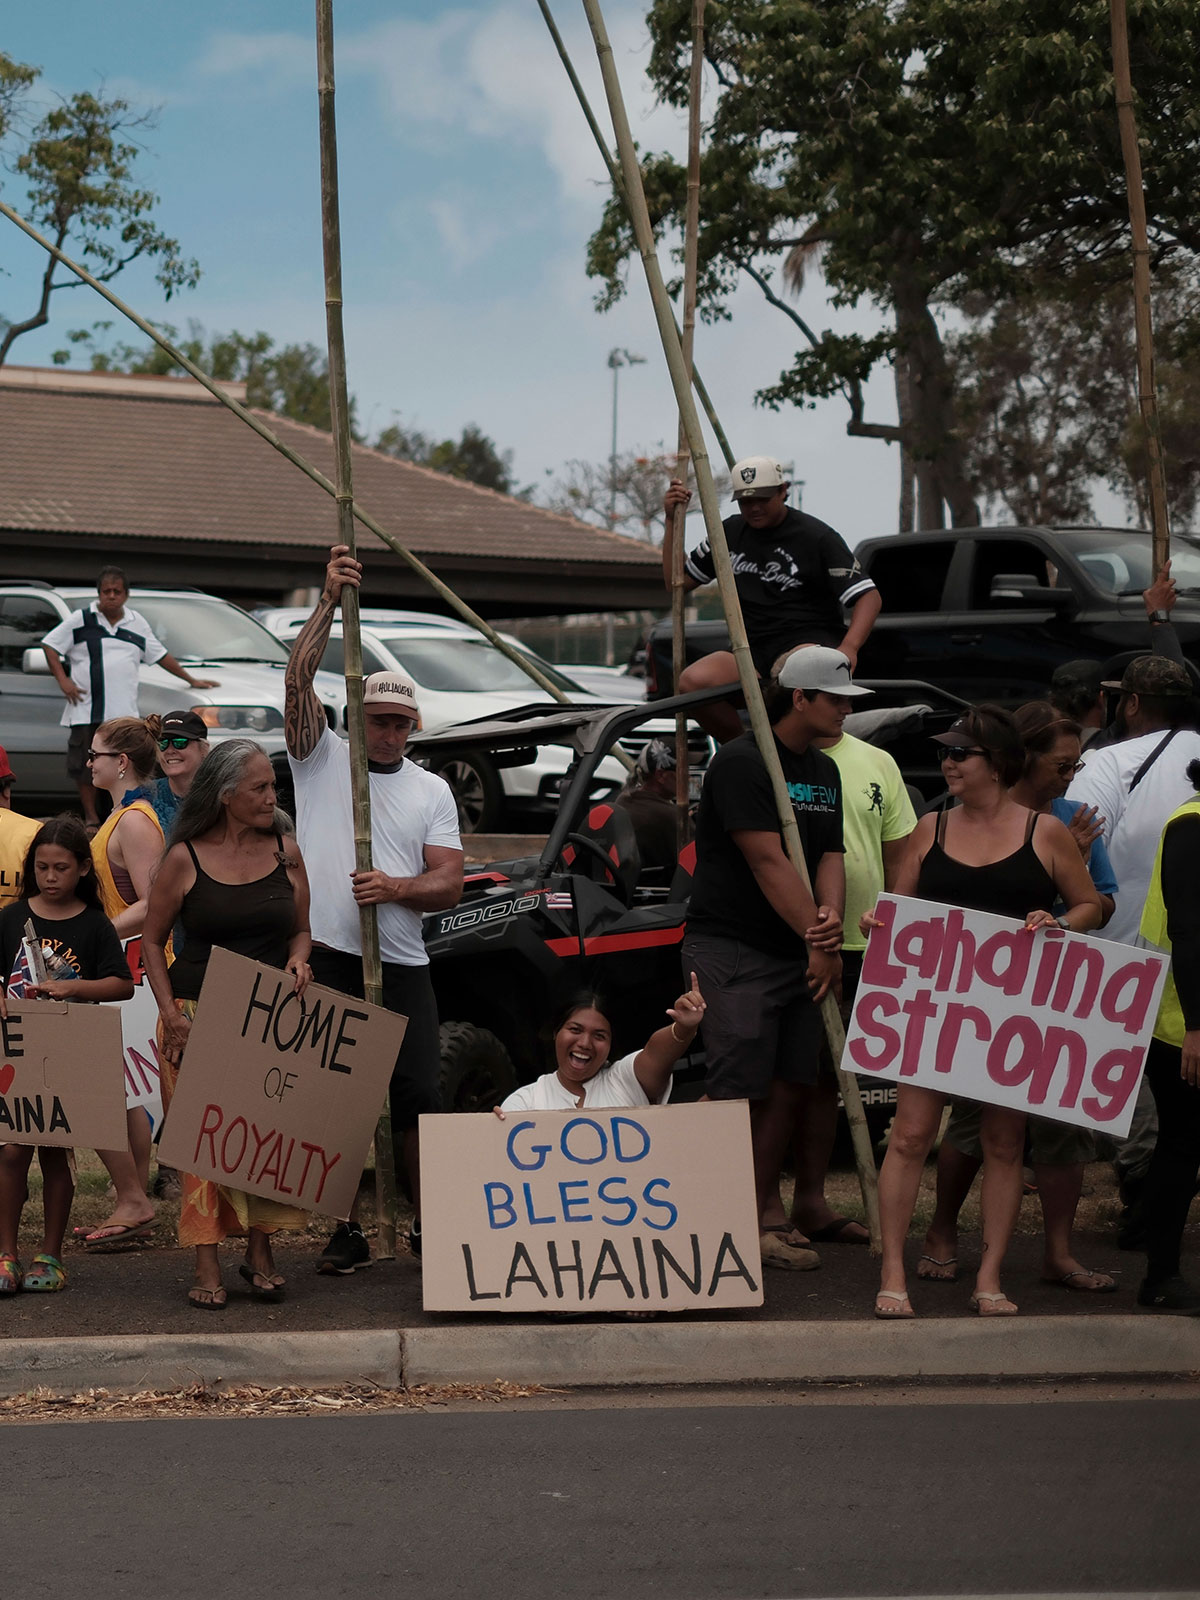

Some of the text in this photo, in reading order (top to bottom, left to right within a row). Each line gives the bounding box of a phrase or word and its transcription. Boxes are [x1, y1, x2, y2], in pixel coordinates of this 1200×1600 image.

[441, 895, 540, 933] 1000
[862, 900, 1162, 1035] Lahaina
[241, 972, 369, 1074] HOME
[849, 989, 1147, 1122] strong
[264, 1067, 299, 1103] OF
[193, 1104, 341, 1203] ROYALTY
[507, 1116, 651, 1171] GOD
[484, 1176, 678, 1231] BLESS
[462, 1232, 758, 1301] LAHAINA
